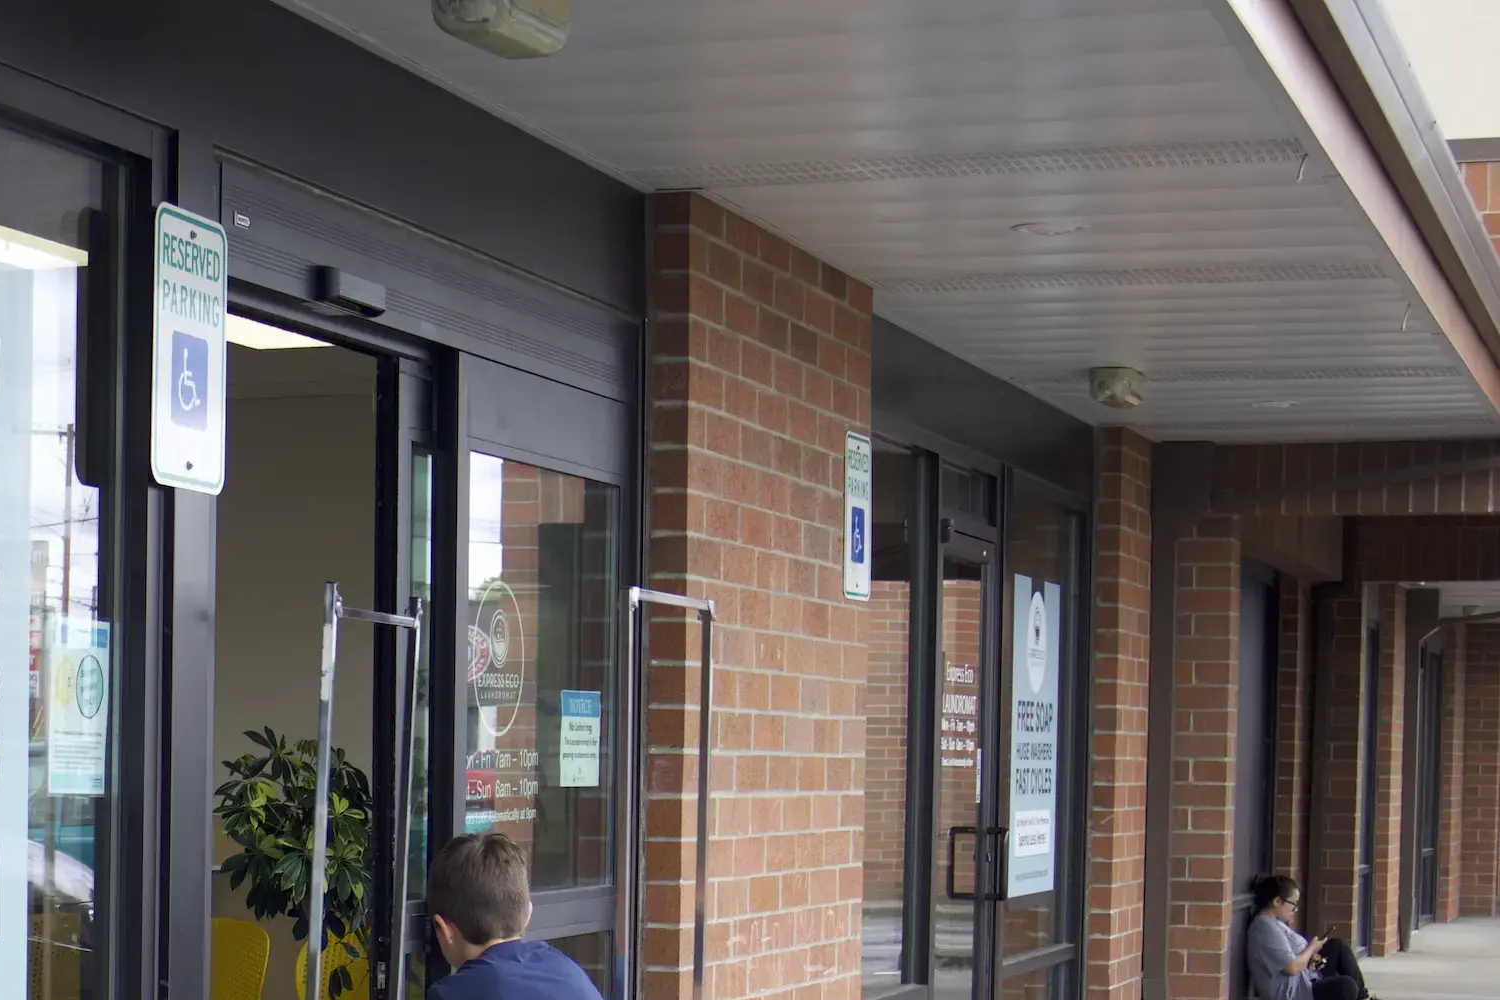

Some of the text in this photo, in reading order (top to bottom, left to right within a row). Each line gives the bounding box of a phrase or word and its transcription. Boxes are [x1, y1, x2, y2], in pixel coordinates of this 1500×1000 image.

[162, 231, 220, 283] RESERVED
[162, 279, 219, 328] PARKING
[478, 673, 519, 688] EXPRESS ECO
[480, 690, 517, 700] LAUNDROMAT
[569, 698, 592, 714] NOTICE
[1017, 699, 1053, 733] FREE SOAP
[481, 751, 491, 768] Fri
[495, 750, 511, 768] 7am
[520, 749, 539, 771] 10pm
[477, 780, 491, 799] Sun
[495, 780, 511, 798] 6am
[520, 778, 538, 800] 10pm
[1016, 768, 1052, 795] FAST CYCLES
